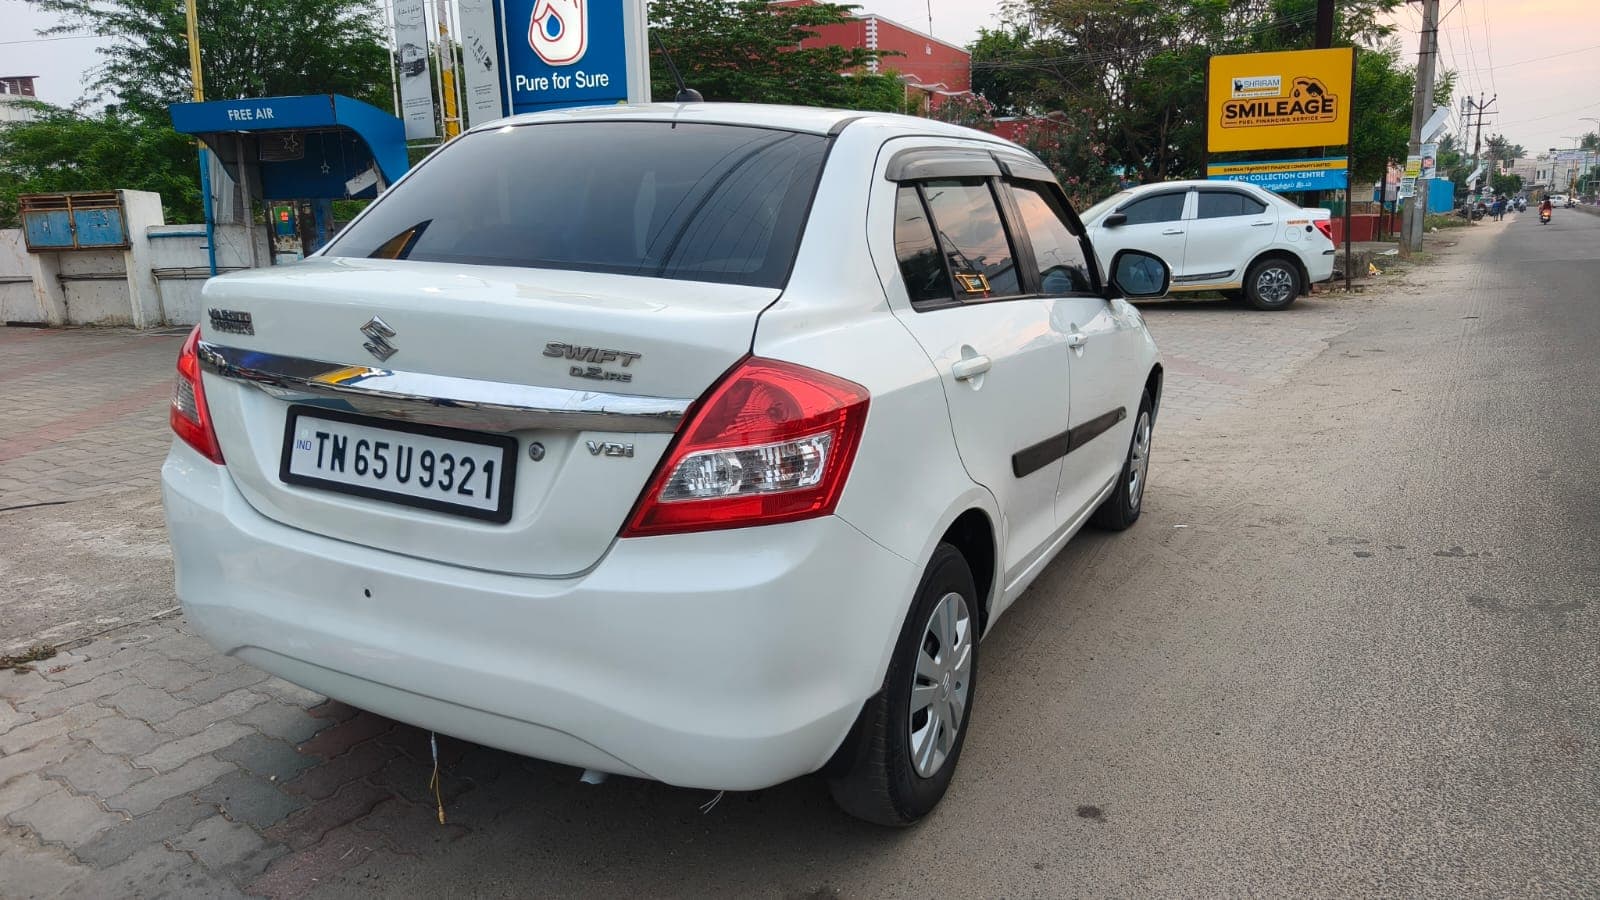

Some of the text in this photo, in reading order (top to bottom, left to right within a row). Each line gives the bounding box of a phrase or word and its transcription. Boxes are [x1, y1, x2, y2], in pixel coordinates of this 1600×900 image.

[516, 70, 609, 92] Pure for Sure
[227, 107, 275, 121] FREE AIR
[1225, 98, 1334, 119] SMILEAGE
[1250, 172, 1295, 181] COLLECTION
[1298, 171, 1325, 179] CENTRE
[543, 341, 642, 367] SWIFT
[296, 439, 312, 451] IND
